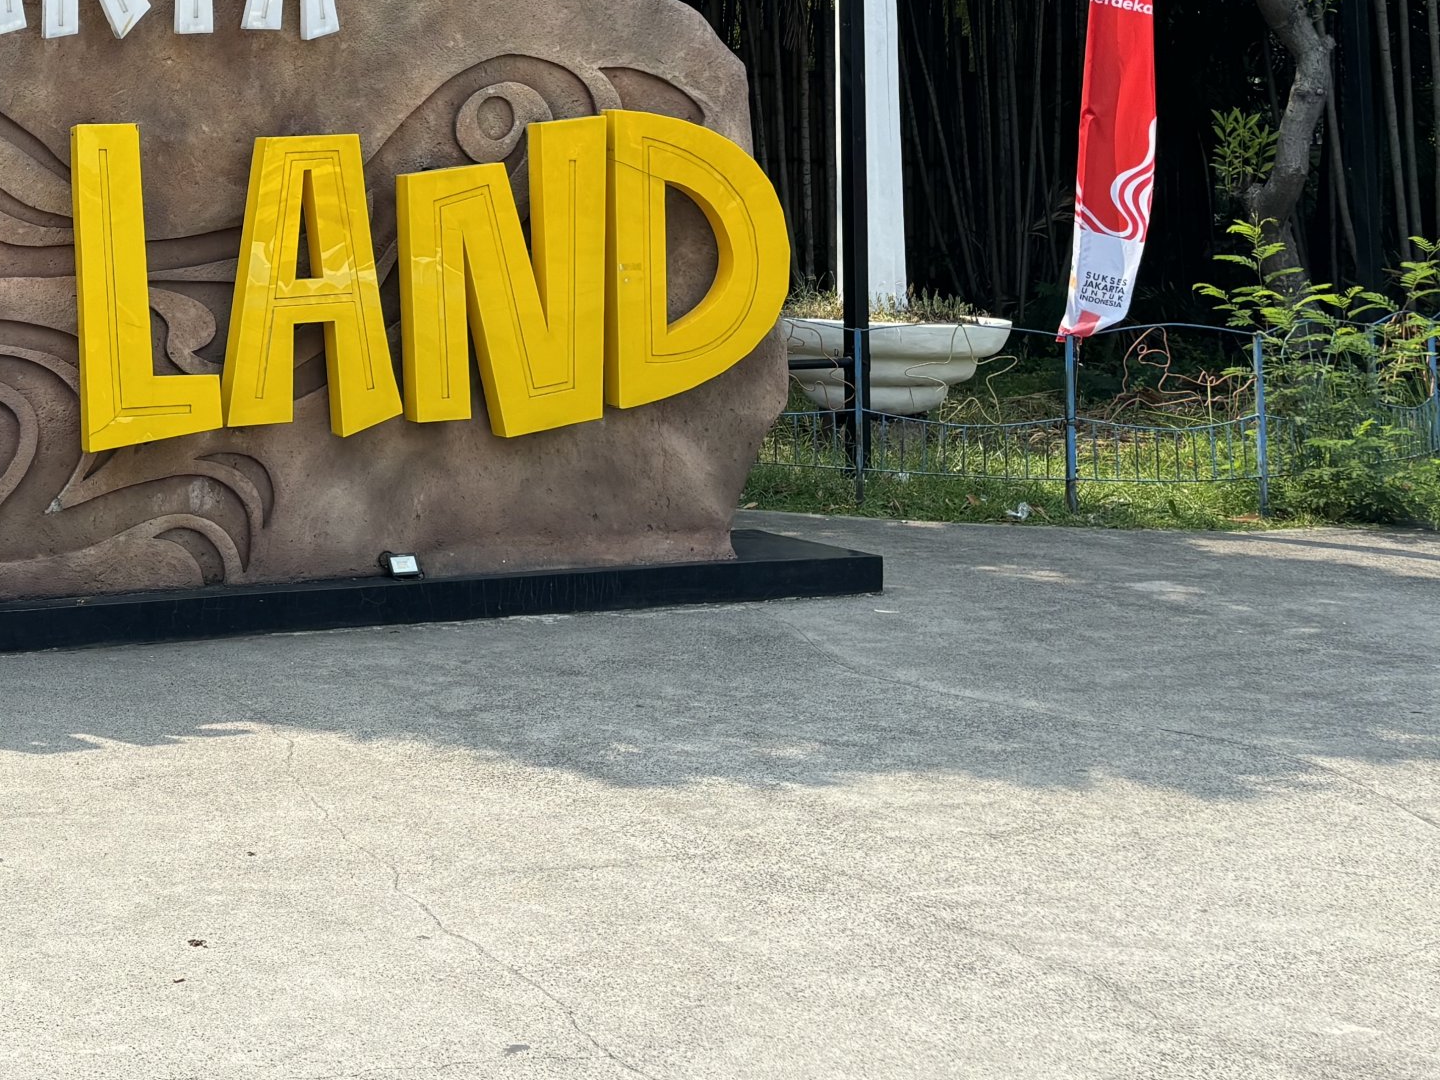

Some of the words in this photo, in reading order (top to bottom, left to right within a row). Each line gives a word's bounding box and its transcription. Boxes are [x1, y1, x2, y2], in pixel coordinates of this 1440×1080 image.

[71, 109, 791, 453] LAND
[1083, 279, 1125, 295] JAKARTA
[1085, 271, 1127, 287] SUKSES
[1079, 294, 1122, 308] INDONESIA
[1081, 287, 1123, 302] UNTUK
